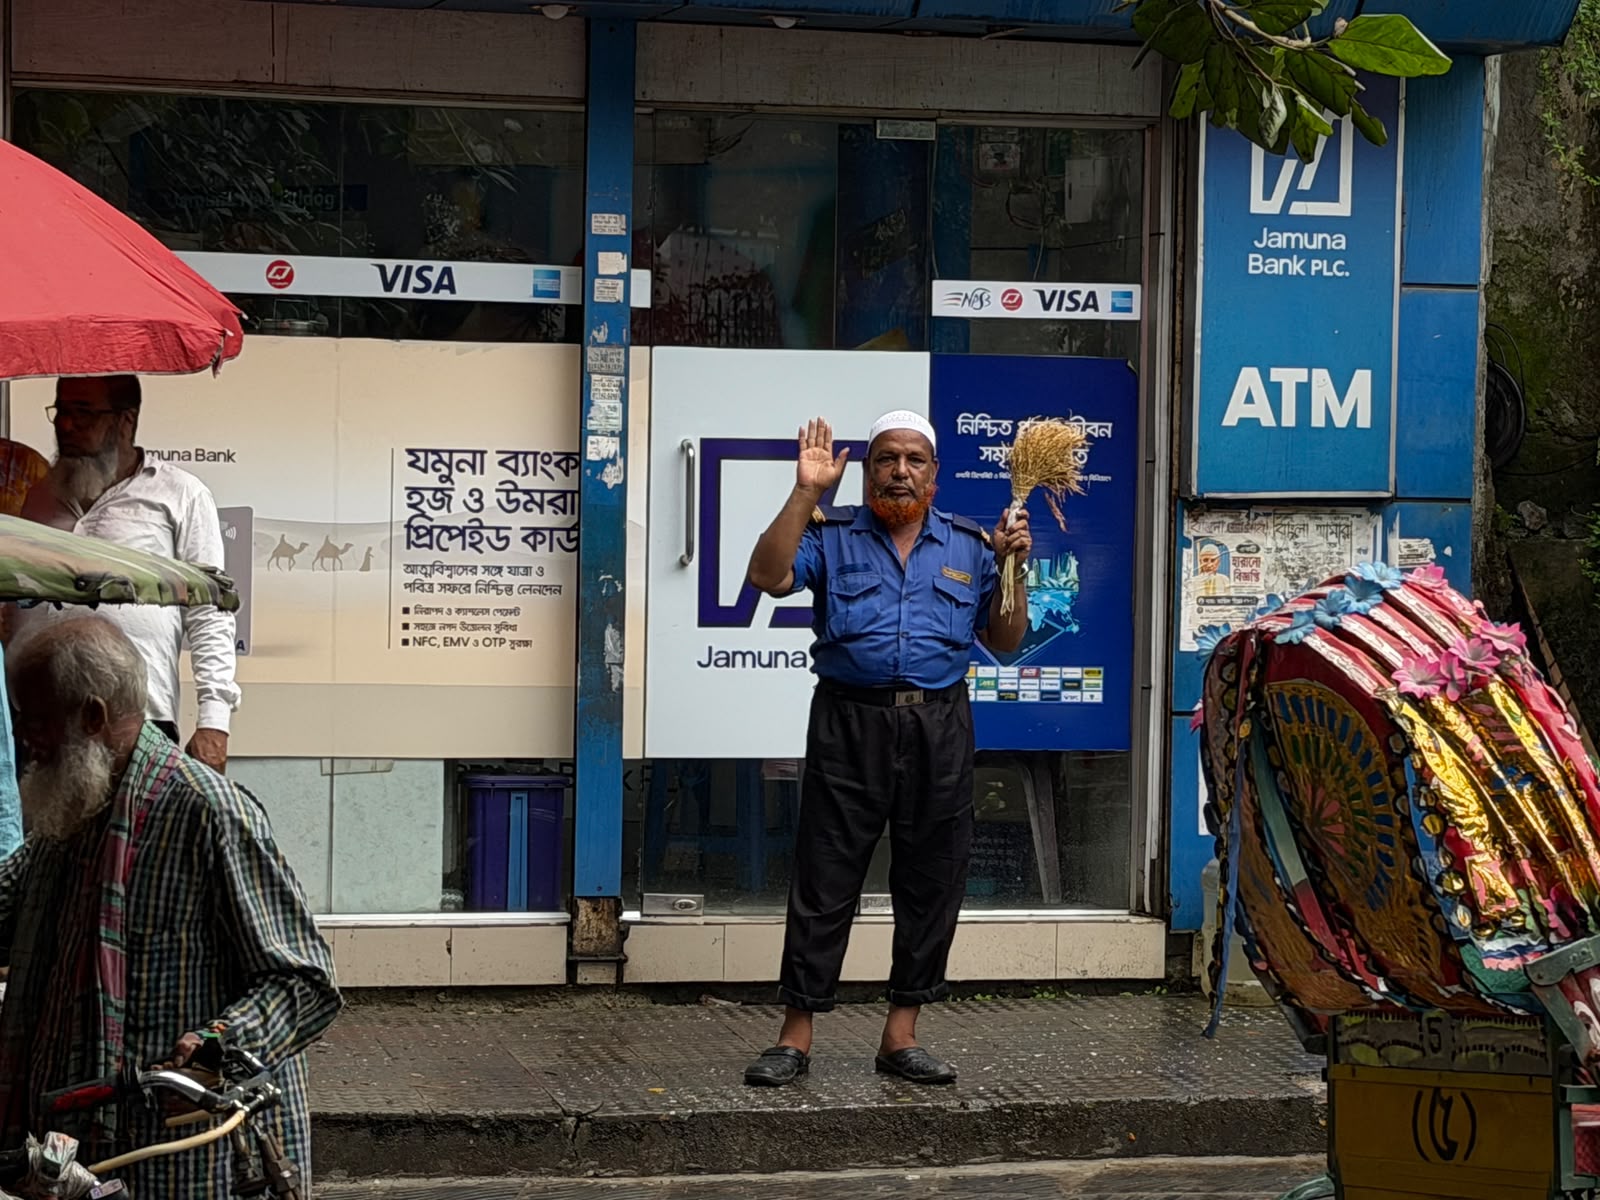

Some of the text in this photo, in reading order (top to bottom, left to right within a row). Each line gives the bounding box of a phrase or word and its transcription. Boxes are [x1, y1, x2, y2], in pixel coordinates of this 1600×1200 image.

[1253, 227, 1346, 251] Jamuna
[1247, 253, 1350, 277] Bank PLC.
[371, 264, 457, 295] VISA
[1032, 289, 1099, 313] VISA
[1221, 366, 1373, 429] ATM
[956, 412, 1013, 437] নিশ্চিত
[146, 447, 236, 463] muna Bank
[405, 447, 488, 485] যমুনা
[495, 450, 579, 481] ব্যাংক
[404, 479, 578, 518] হজ ও উমরা
[404, 514, 512, 554] প্রিপেইড
[403, 560, 545, 579] আত্মবিশ্বাসের সঙ্গে যাত্রা ও
[1231, 556, 1261, 569] হারানো
[403, 578, 563, 596] পবিত্র সফরে নিশ্চিন্ত লেনদেন
[1233, 568, 1261, 583] বিজ্ঞপ্তি
[445, 608, 453, 616] ও
[412, 636, 440, 649] NFC,
[443, 636, 471, 648] EMV
[472, 639, 480, 648] ও
[482, 636, 507, 648] OTP
[696, 645, 808, 669] Jamuna
